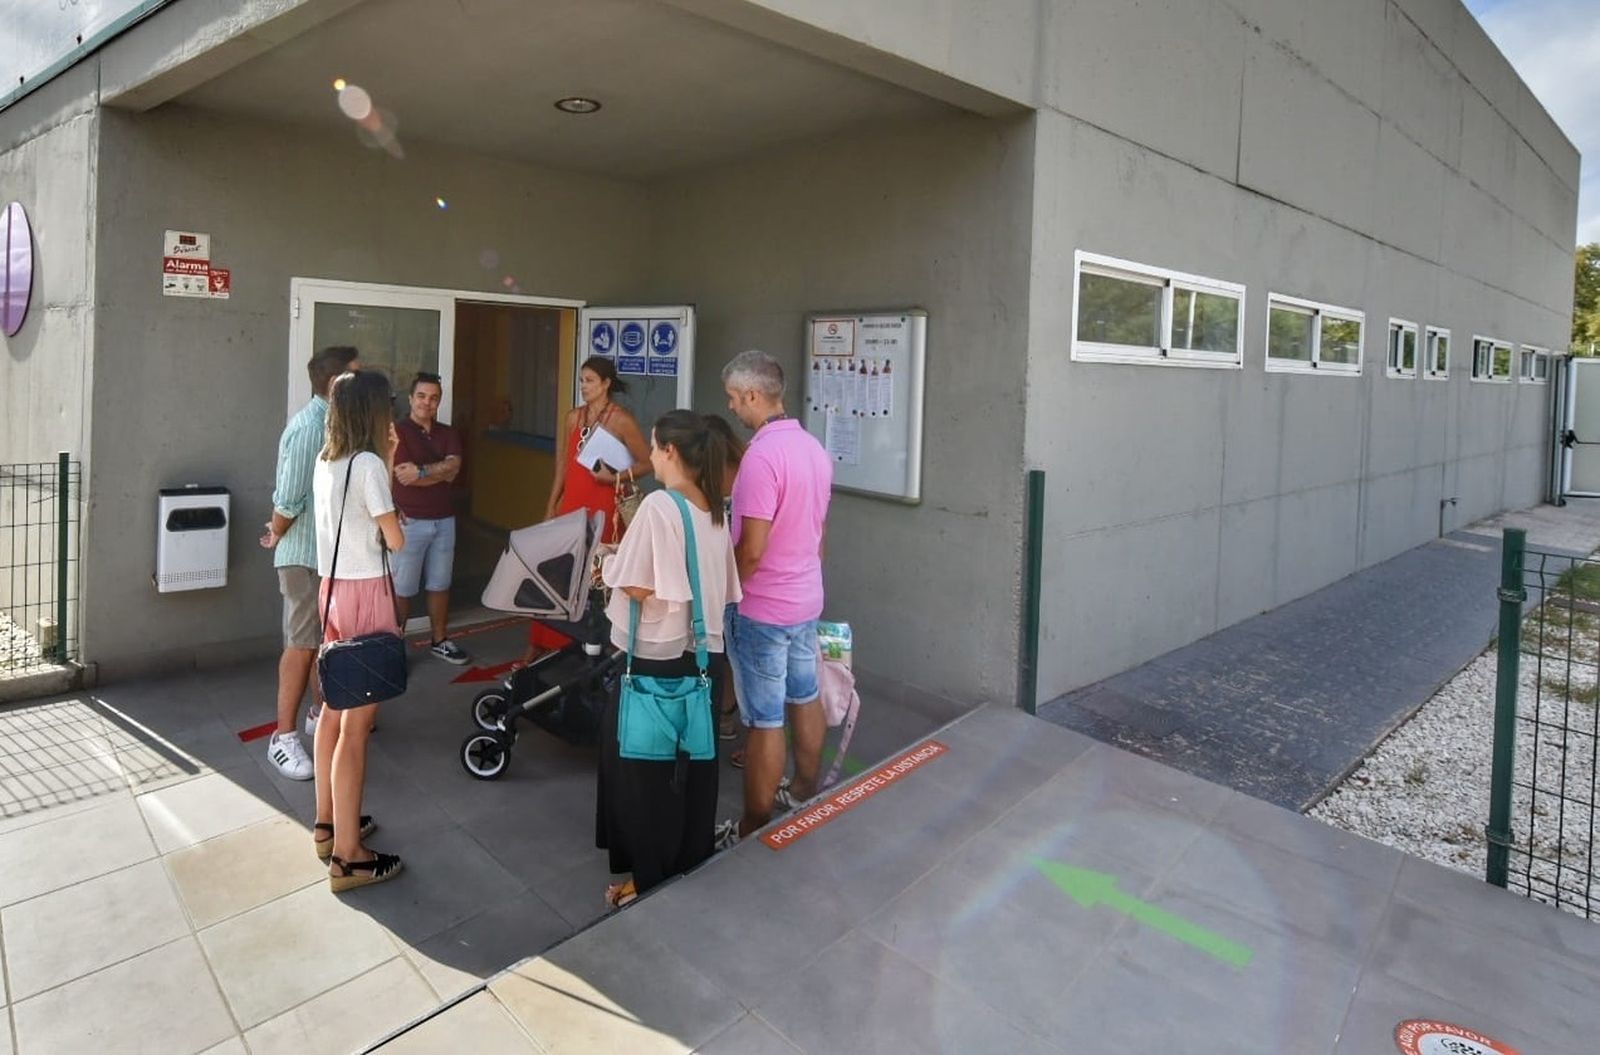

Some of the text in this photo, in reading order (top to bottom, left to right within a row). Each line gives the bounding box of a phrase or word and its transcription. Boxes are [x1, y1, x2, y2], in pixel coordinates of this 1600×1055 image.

[166, 259, 208, 271] Alarma
[770, 745, 943, 844] POR FAVOR, RESPETE LA DISTANCIA
[1434, 1024, 1491, 1046] FAVOR
